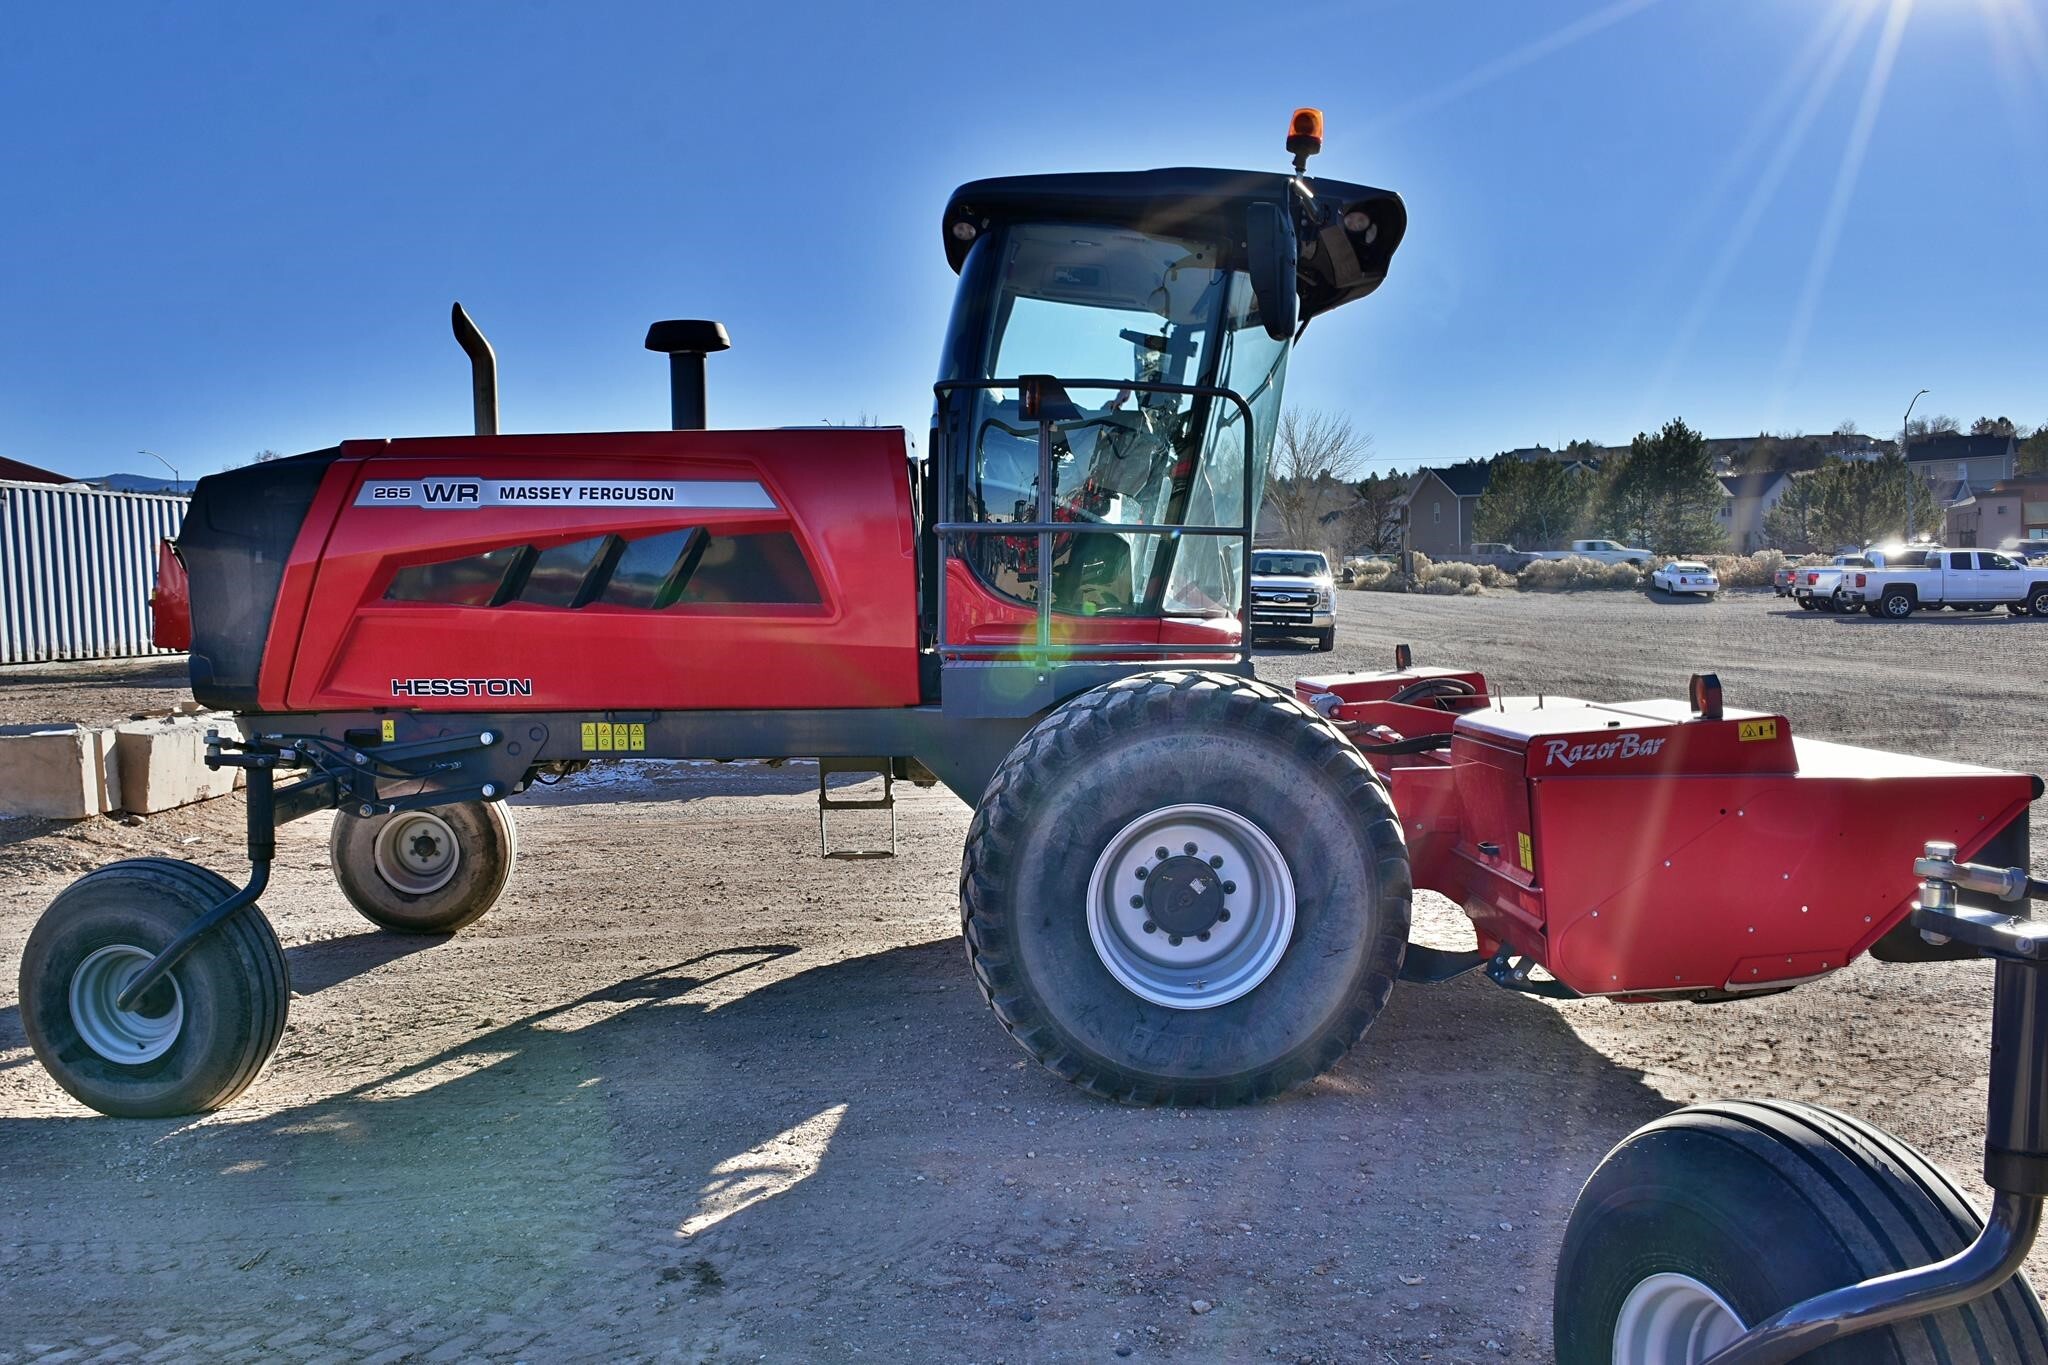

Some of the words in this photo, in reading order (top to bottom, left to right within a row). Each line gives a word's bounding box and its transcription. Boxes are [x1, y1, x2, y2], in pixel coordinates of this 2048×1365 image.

[374, 487, 411, 499] 265
[422, 483, 479, 503] WR
[499, 487, 573, 500] MASSEY
[579, 487, 675, 501] FERGUSON
[391, 679, 532, 696] HESSTON
